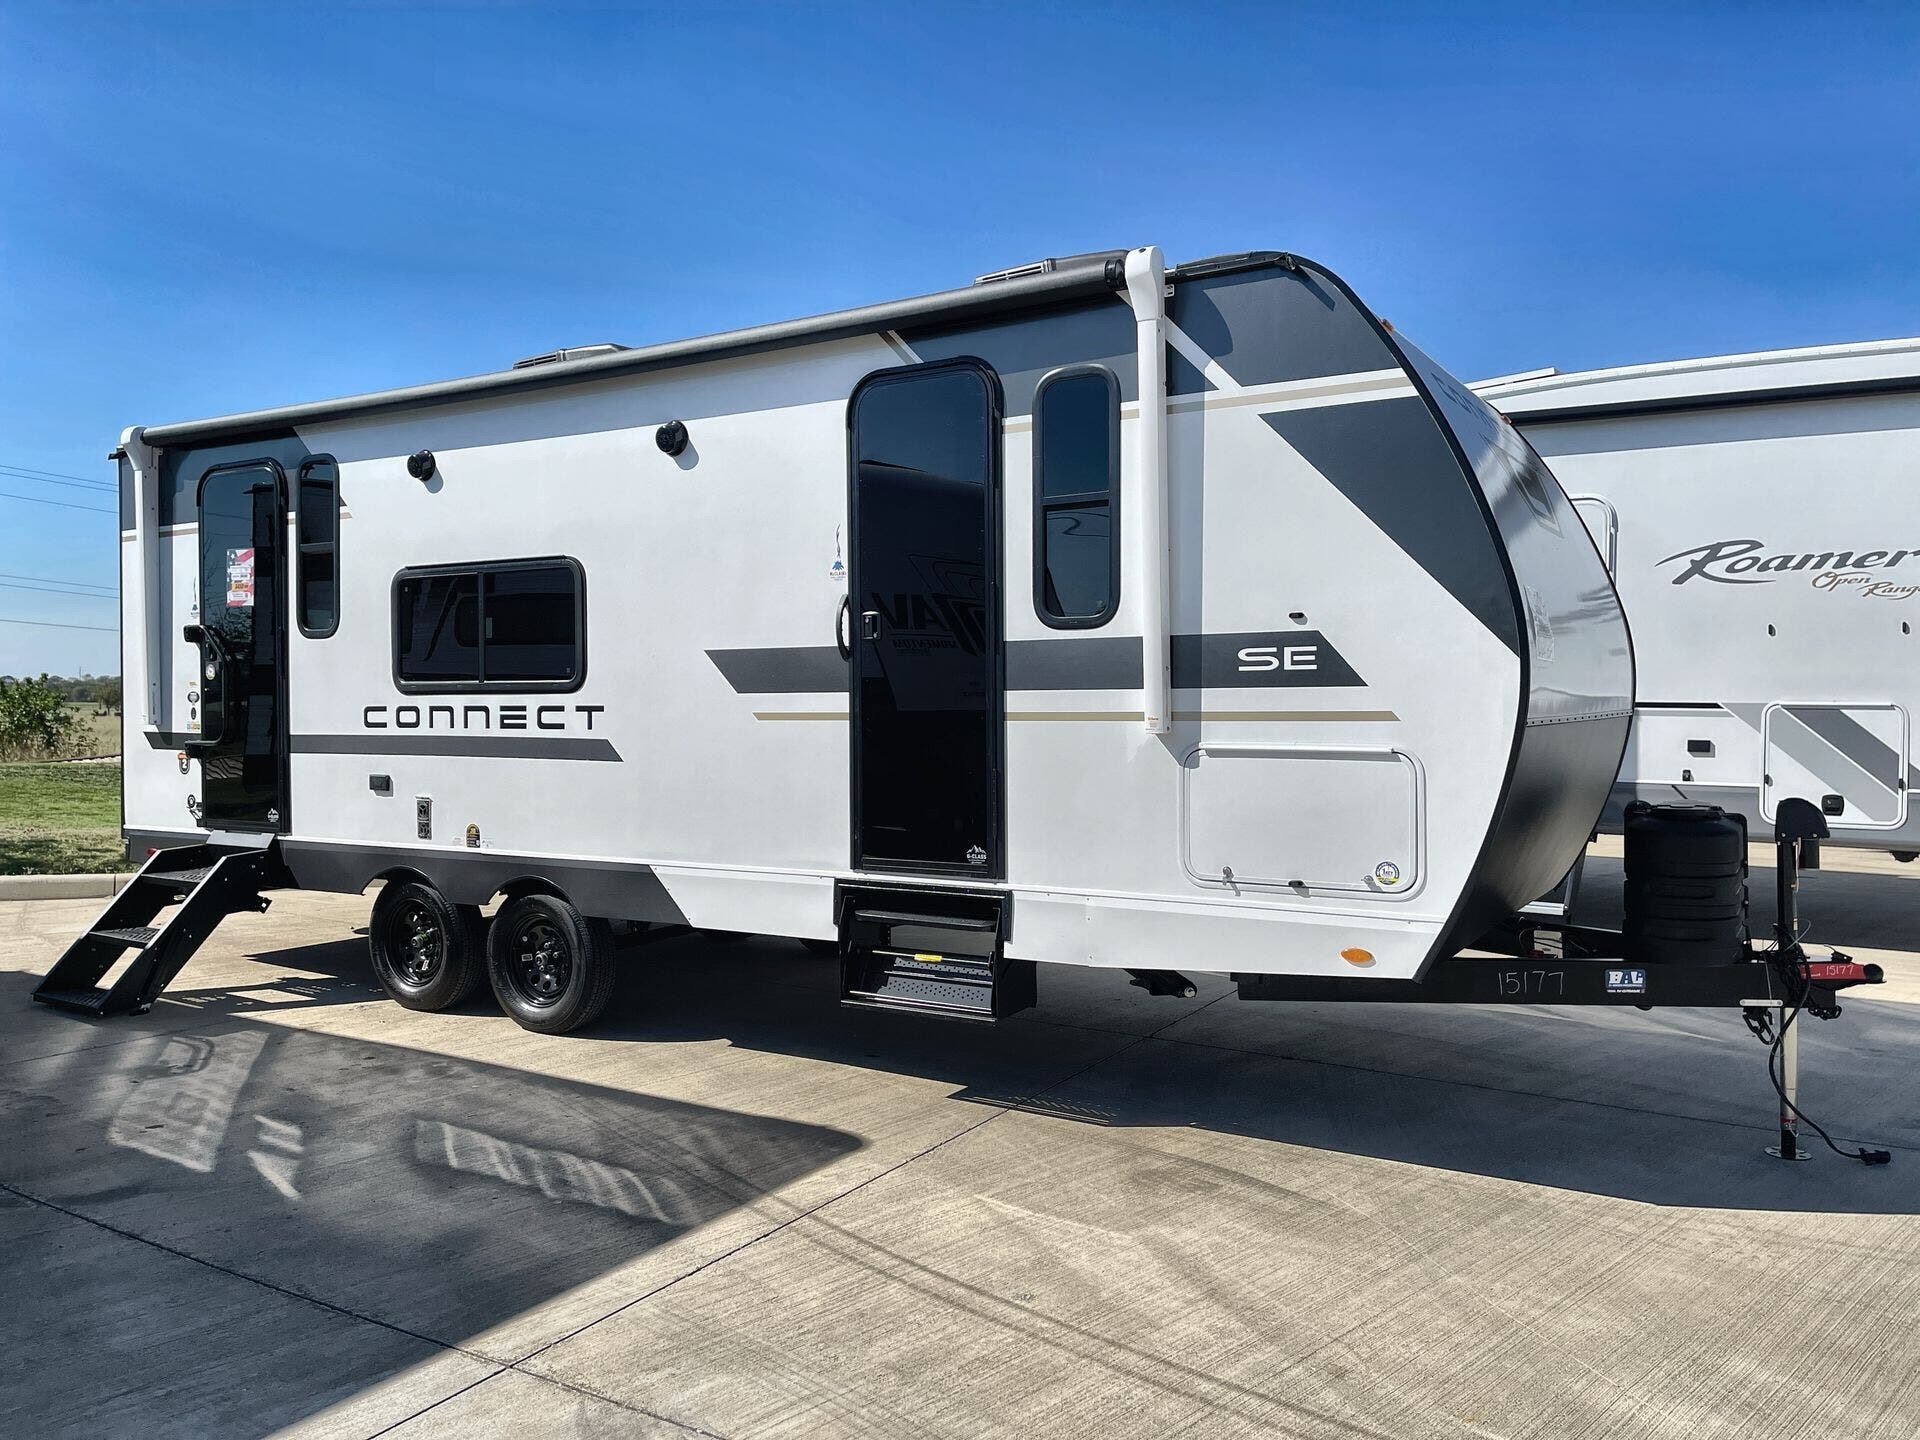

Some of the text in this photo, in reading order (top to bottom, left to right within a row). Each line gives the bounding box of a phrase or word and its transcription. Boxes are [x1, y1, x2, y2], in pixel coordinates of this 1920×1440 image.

[1654, 539, 1920, 585] Roamer
[1811, 571, 1874, 592] Open
[1237, 645, 1318, 672] SE
[363, 705, 605, 730] CONNECT
[1826, 964, 1854, 976] 15177
[1498, 970, 1564, 996] 15177
